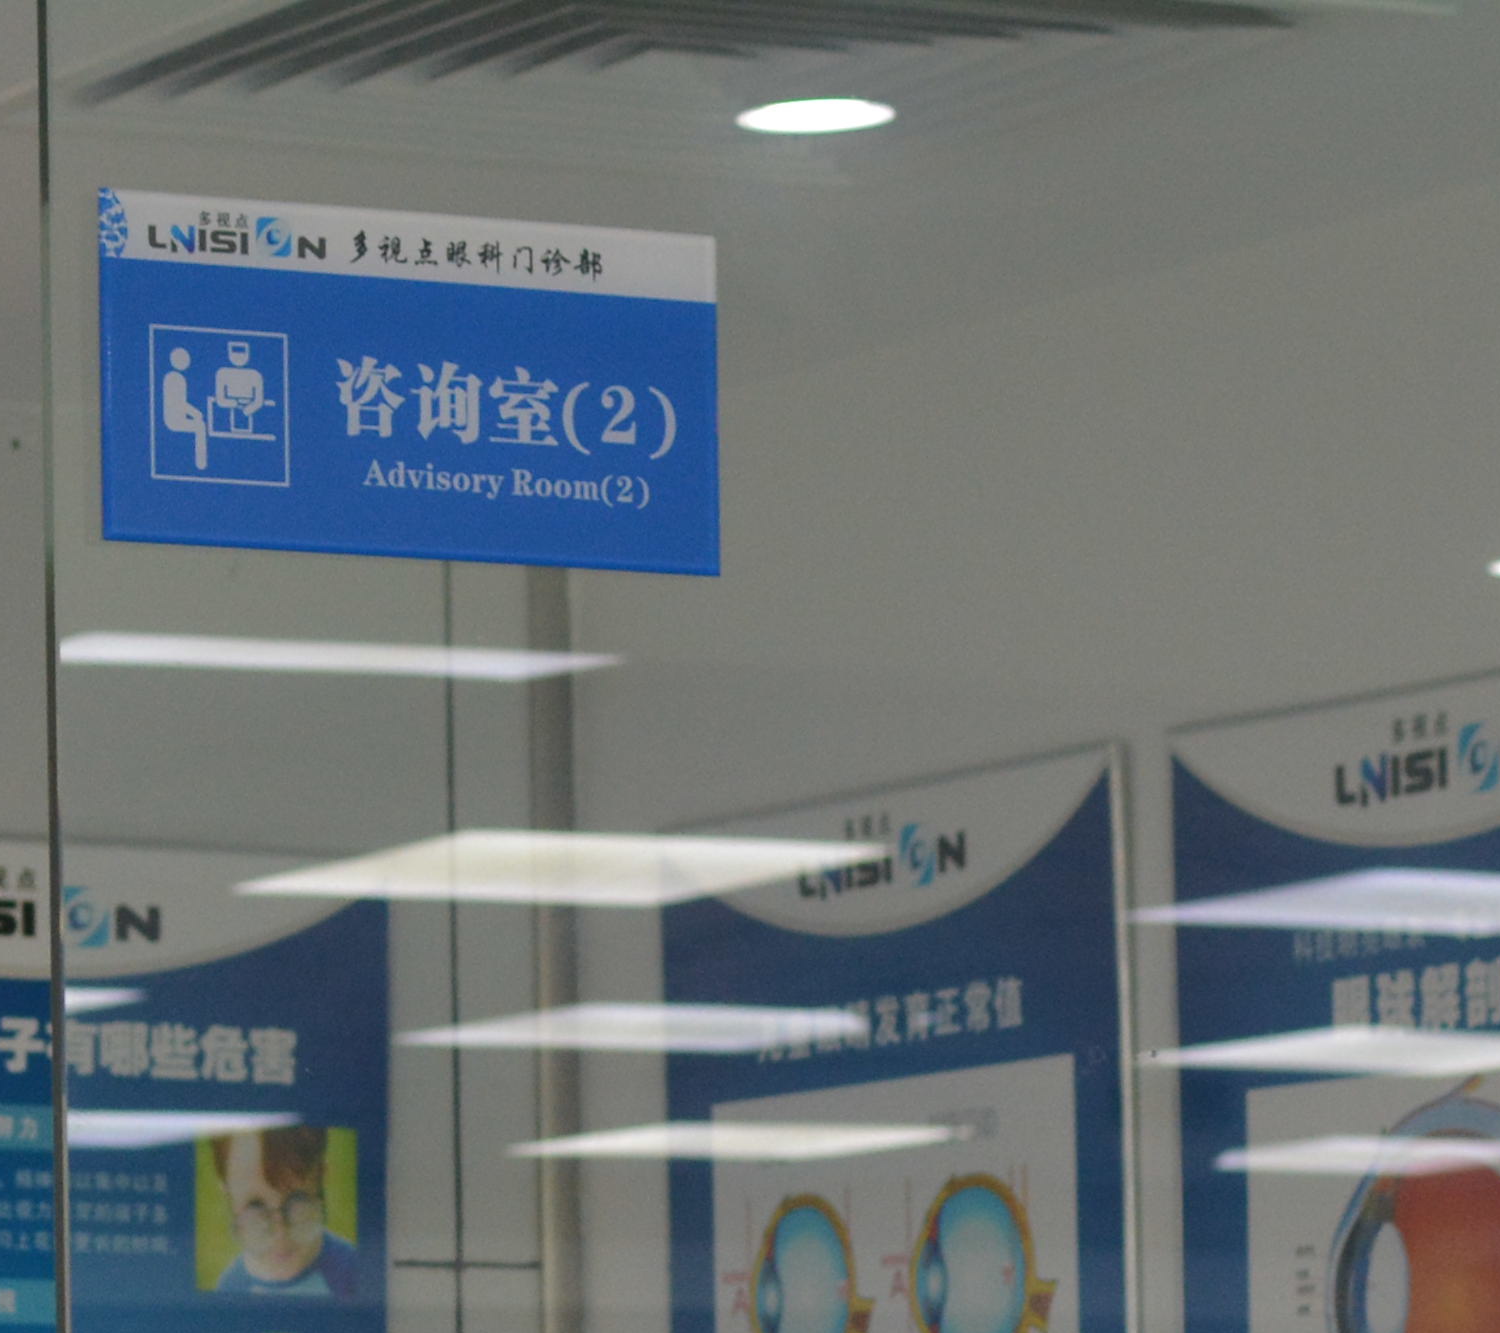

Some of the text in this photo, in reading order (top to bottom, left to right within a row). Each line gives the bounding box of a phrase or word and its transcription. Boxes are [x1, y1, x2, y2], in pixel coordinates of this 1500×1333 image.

[199, 211, 249, 229] 多视点
[348, 230, 604, 282] 多视点眼科门诊部
[336, 356, 677, 461] 咨询室(2)
[363, 459, 651, 510] Advisory Room(2)
